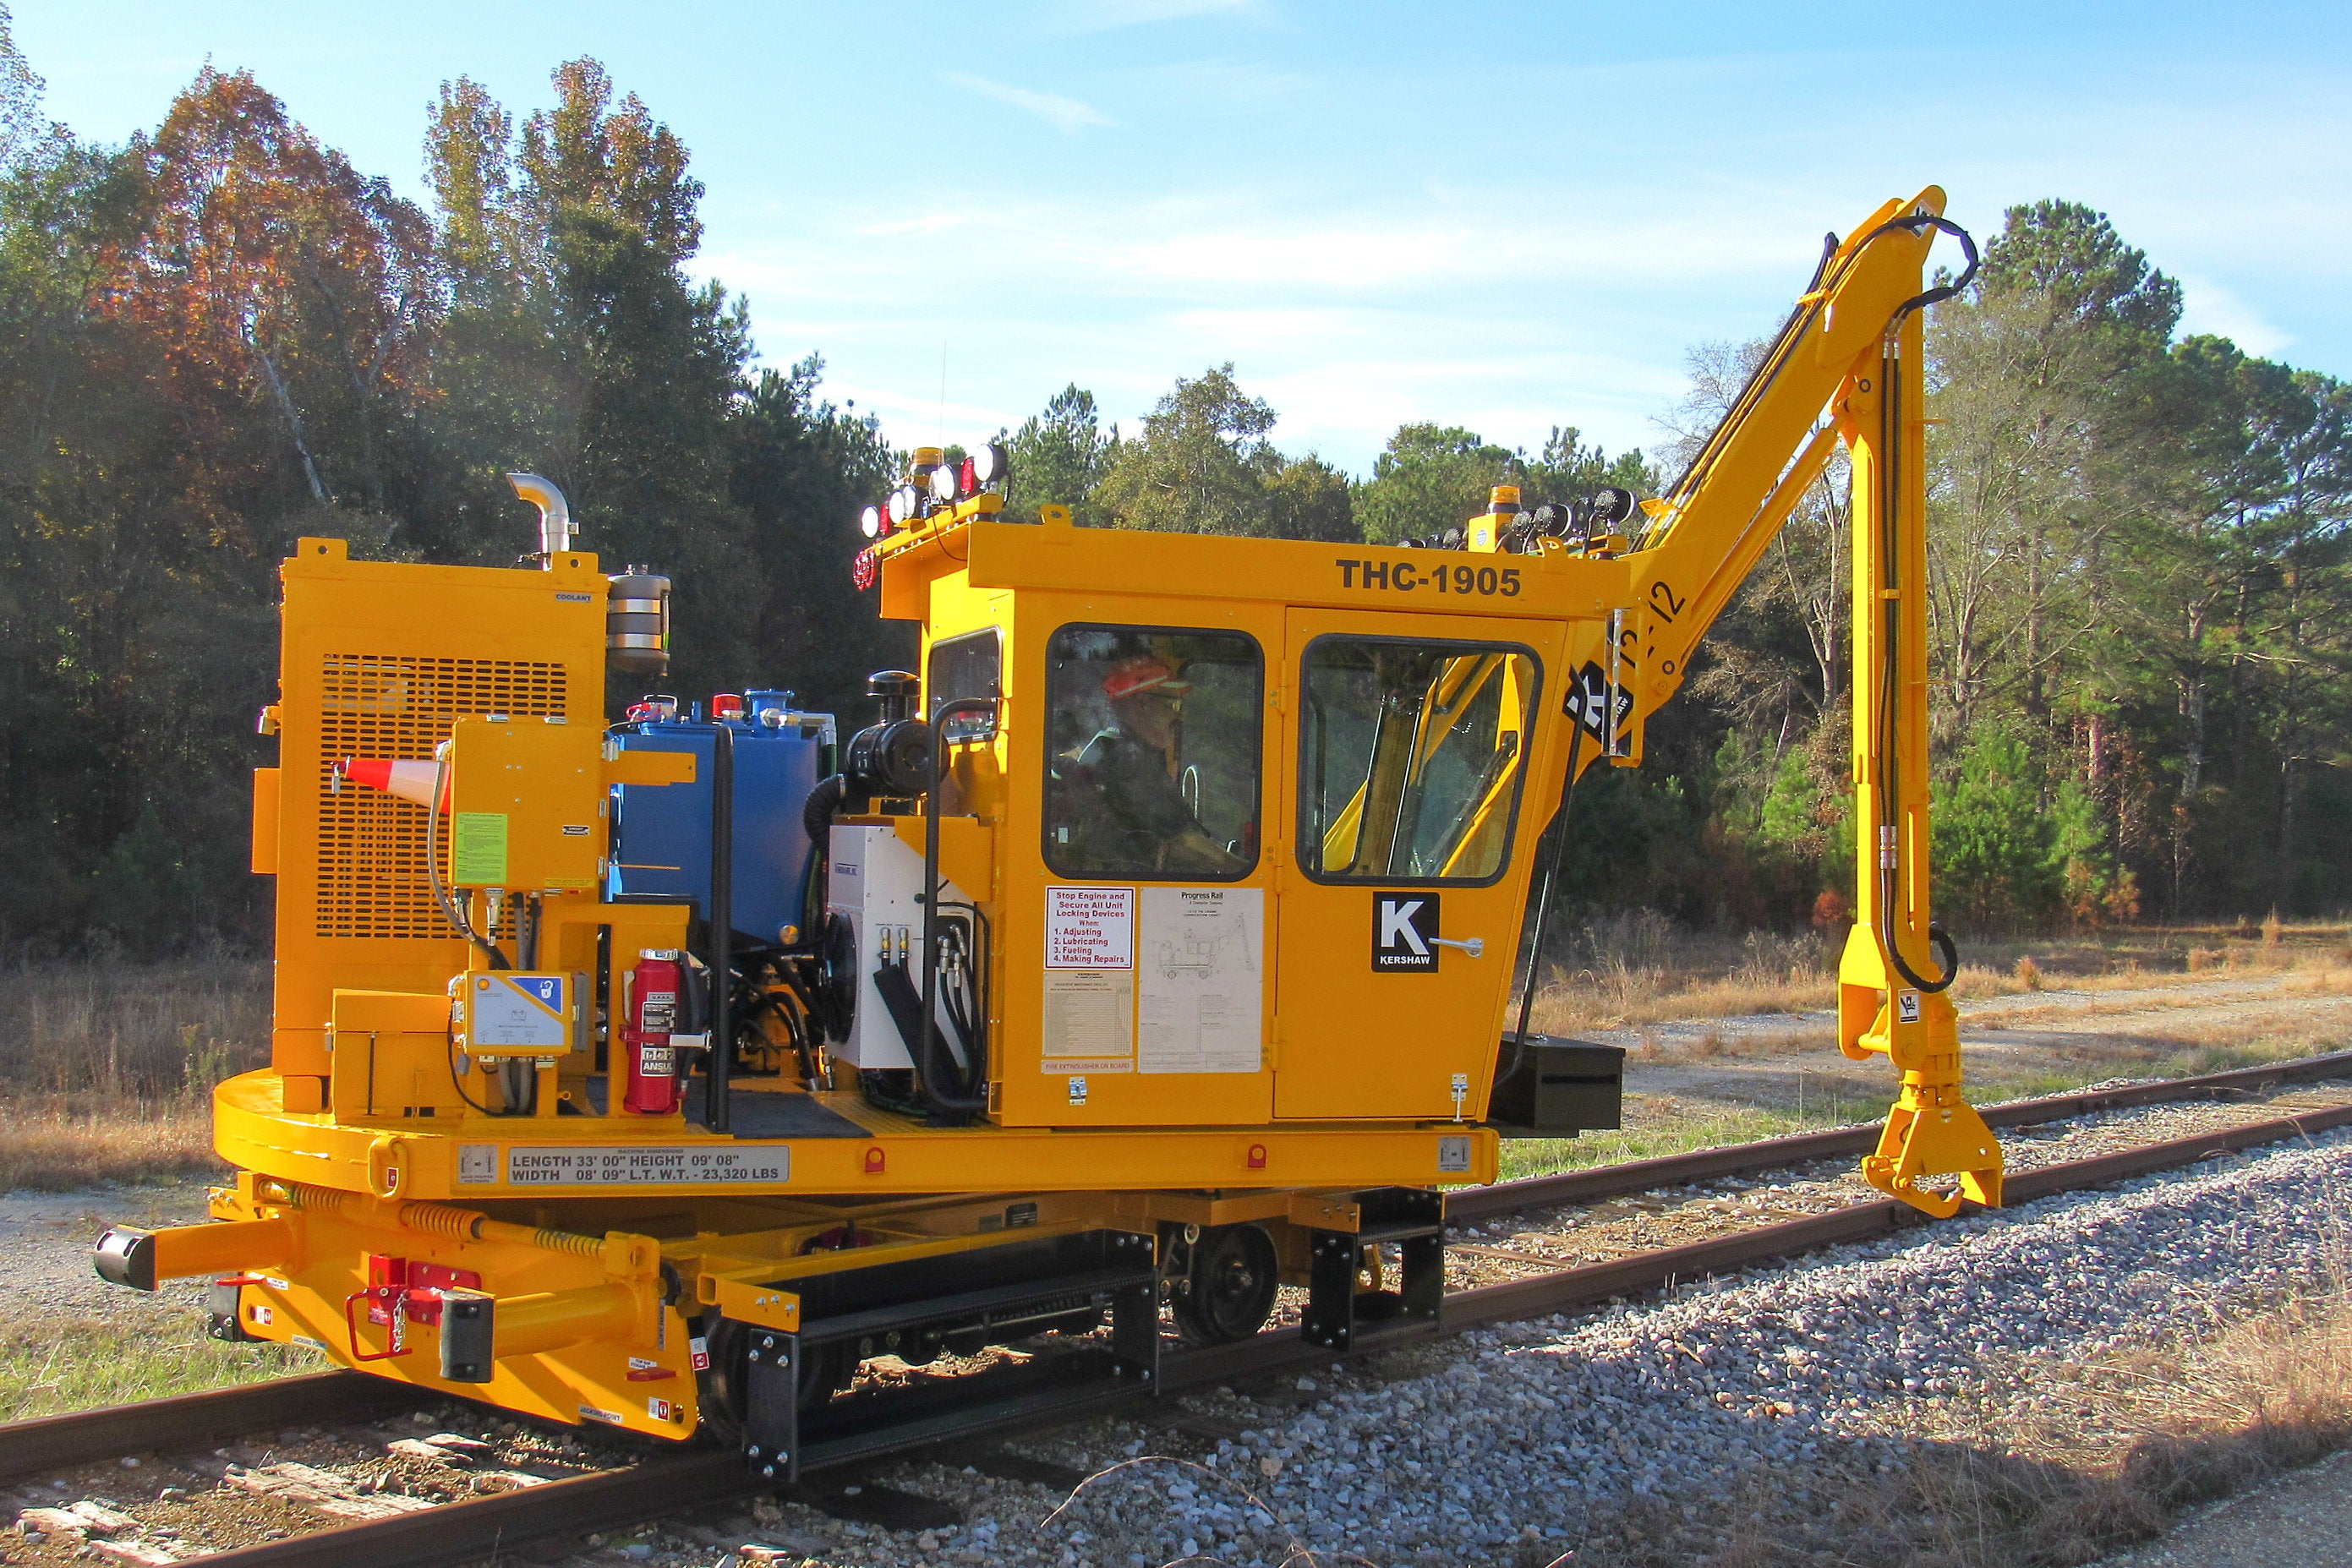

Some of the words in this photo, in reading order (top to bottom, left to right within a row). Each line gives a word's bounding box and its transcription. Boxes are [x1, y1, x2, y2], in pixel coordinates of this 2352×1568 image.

[1336, 559, 1520, 597] THC-1905
[1056, 892, 1075, 900] Stop
[1078, 893, 1107, 901] Engine
[1056, 910, 1090, 918] Locking
[1381, 900, 1430, 955] K
[1064, 928, 1102, 937] Adjusting
[1063, 937, 1108, 947] Lubricating
[1063, 947, 1092, 955] Fueling
[1063, 955, 1091, 964] Making
[1094, 955, 1124, 964] Repairs
[1380, 956, 1430, 965] KERSHAW
[643, 1062, 673, 1071] ANSUL
[512, 1156, 572, 1167] LENGTH
[577, 1156, 597, 1167] 33'
[602, 1156, 626, 1166] 00"
[630, 1156, 684, 1166] HEIGHT
[691, 1155, 711, 1166] 09'
[716, 1155, 739, 1166] 08"
[511, 1170, 561, 1181] WIDTH
[576, 1170, 597, 1181] 08'
[602, 1169, 626, 1181] 09"
[630, 1169, 655, 1180] L.T.
[660, 1168, 690, 1180] W.T.
[702, 1168, 747, 1181] 23,320
[752, 1167, 779, 1179] LBS
